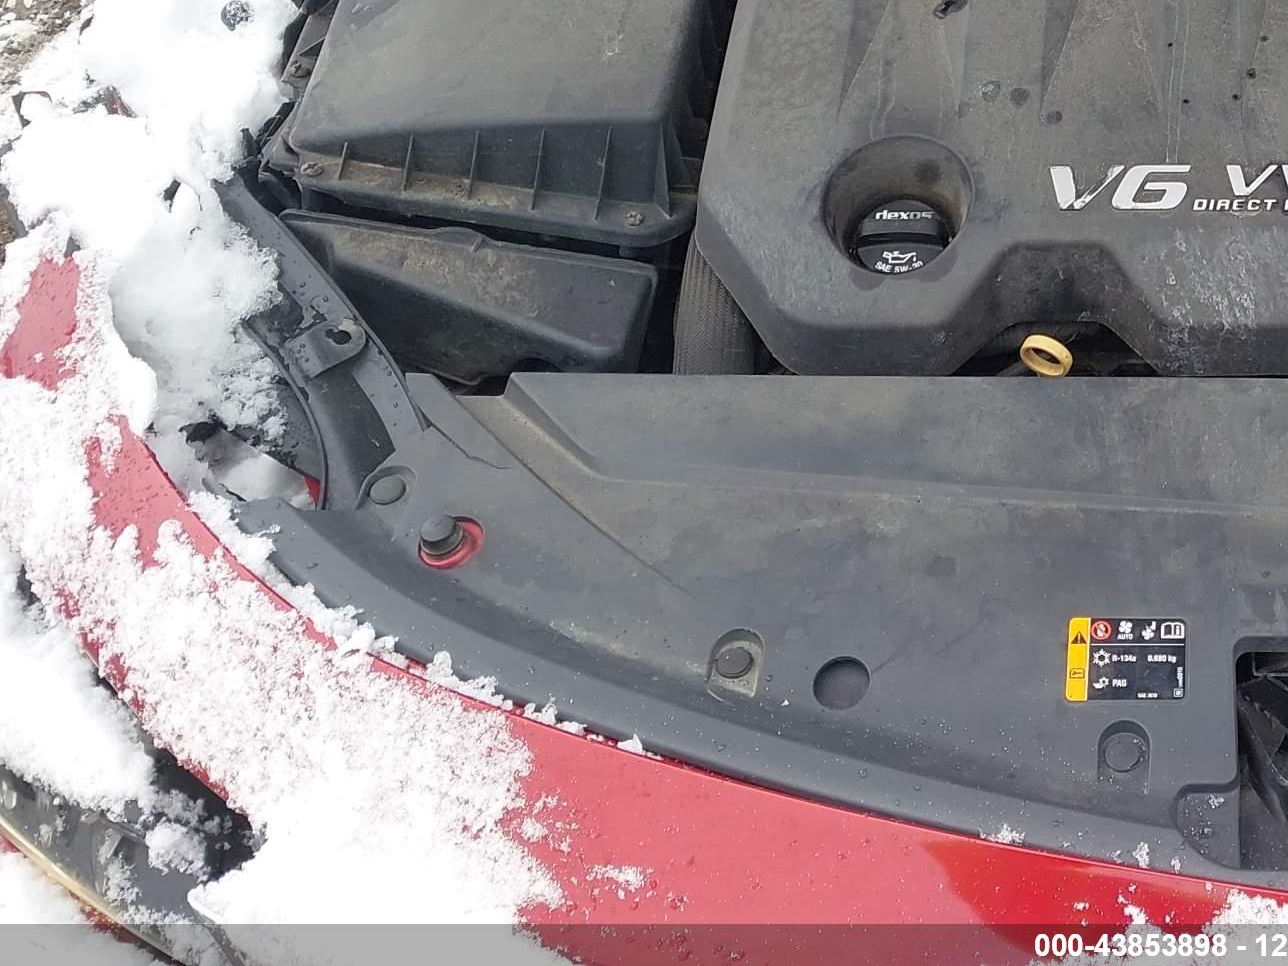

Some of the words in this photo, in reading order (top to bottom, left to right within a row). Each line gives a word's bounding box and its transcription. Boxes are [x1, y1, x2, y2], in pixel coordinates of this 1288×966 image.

[1050, 164, 1192, 210] V6
[1193, 198, 1280, 212] DIRECT
[875, 210, 935, 220] dexos
[874, 261, 892, 273] SAE
